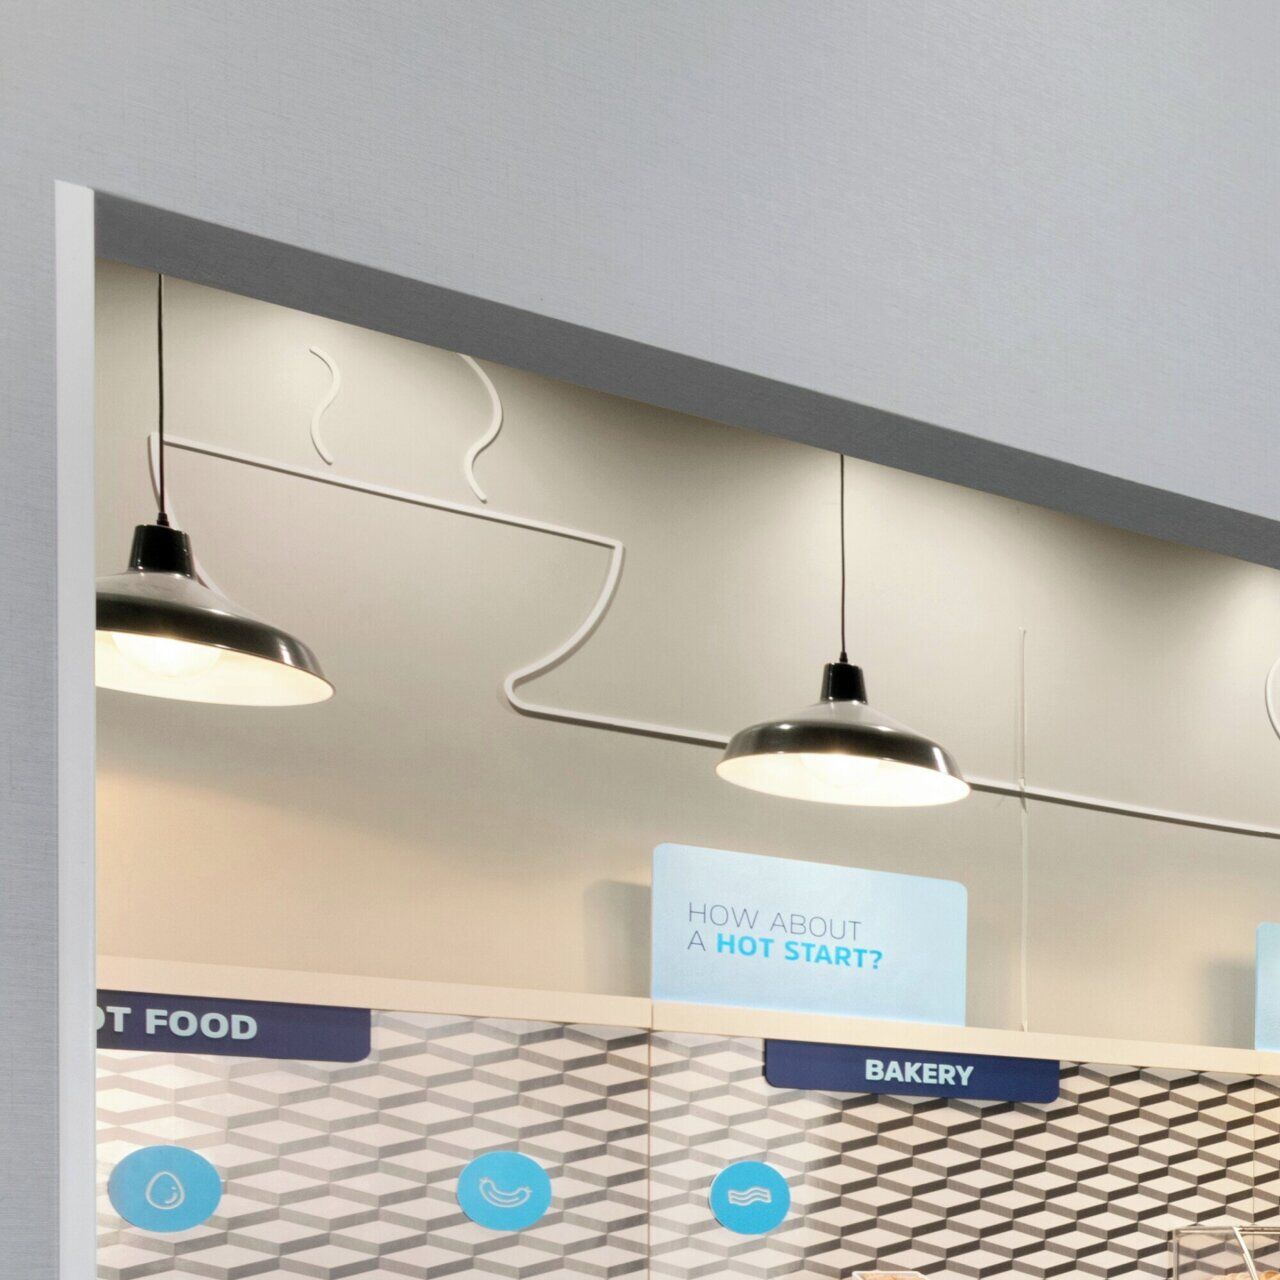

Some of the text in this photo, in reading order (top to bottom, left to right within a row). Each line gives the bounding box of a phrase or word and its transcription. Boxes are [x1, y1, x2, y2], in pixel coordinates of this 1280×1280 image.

[688, 902, 862, 942] HOW ABOUT
[687, 930, 883, 970] A HOT START?
[145, 1008, 258, 1041] FOOD
[865, 1058, 975, 1087] BAKERY
